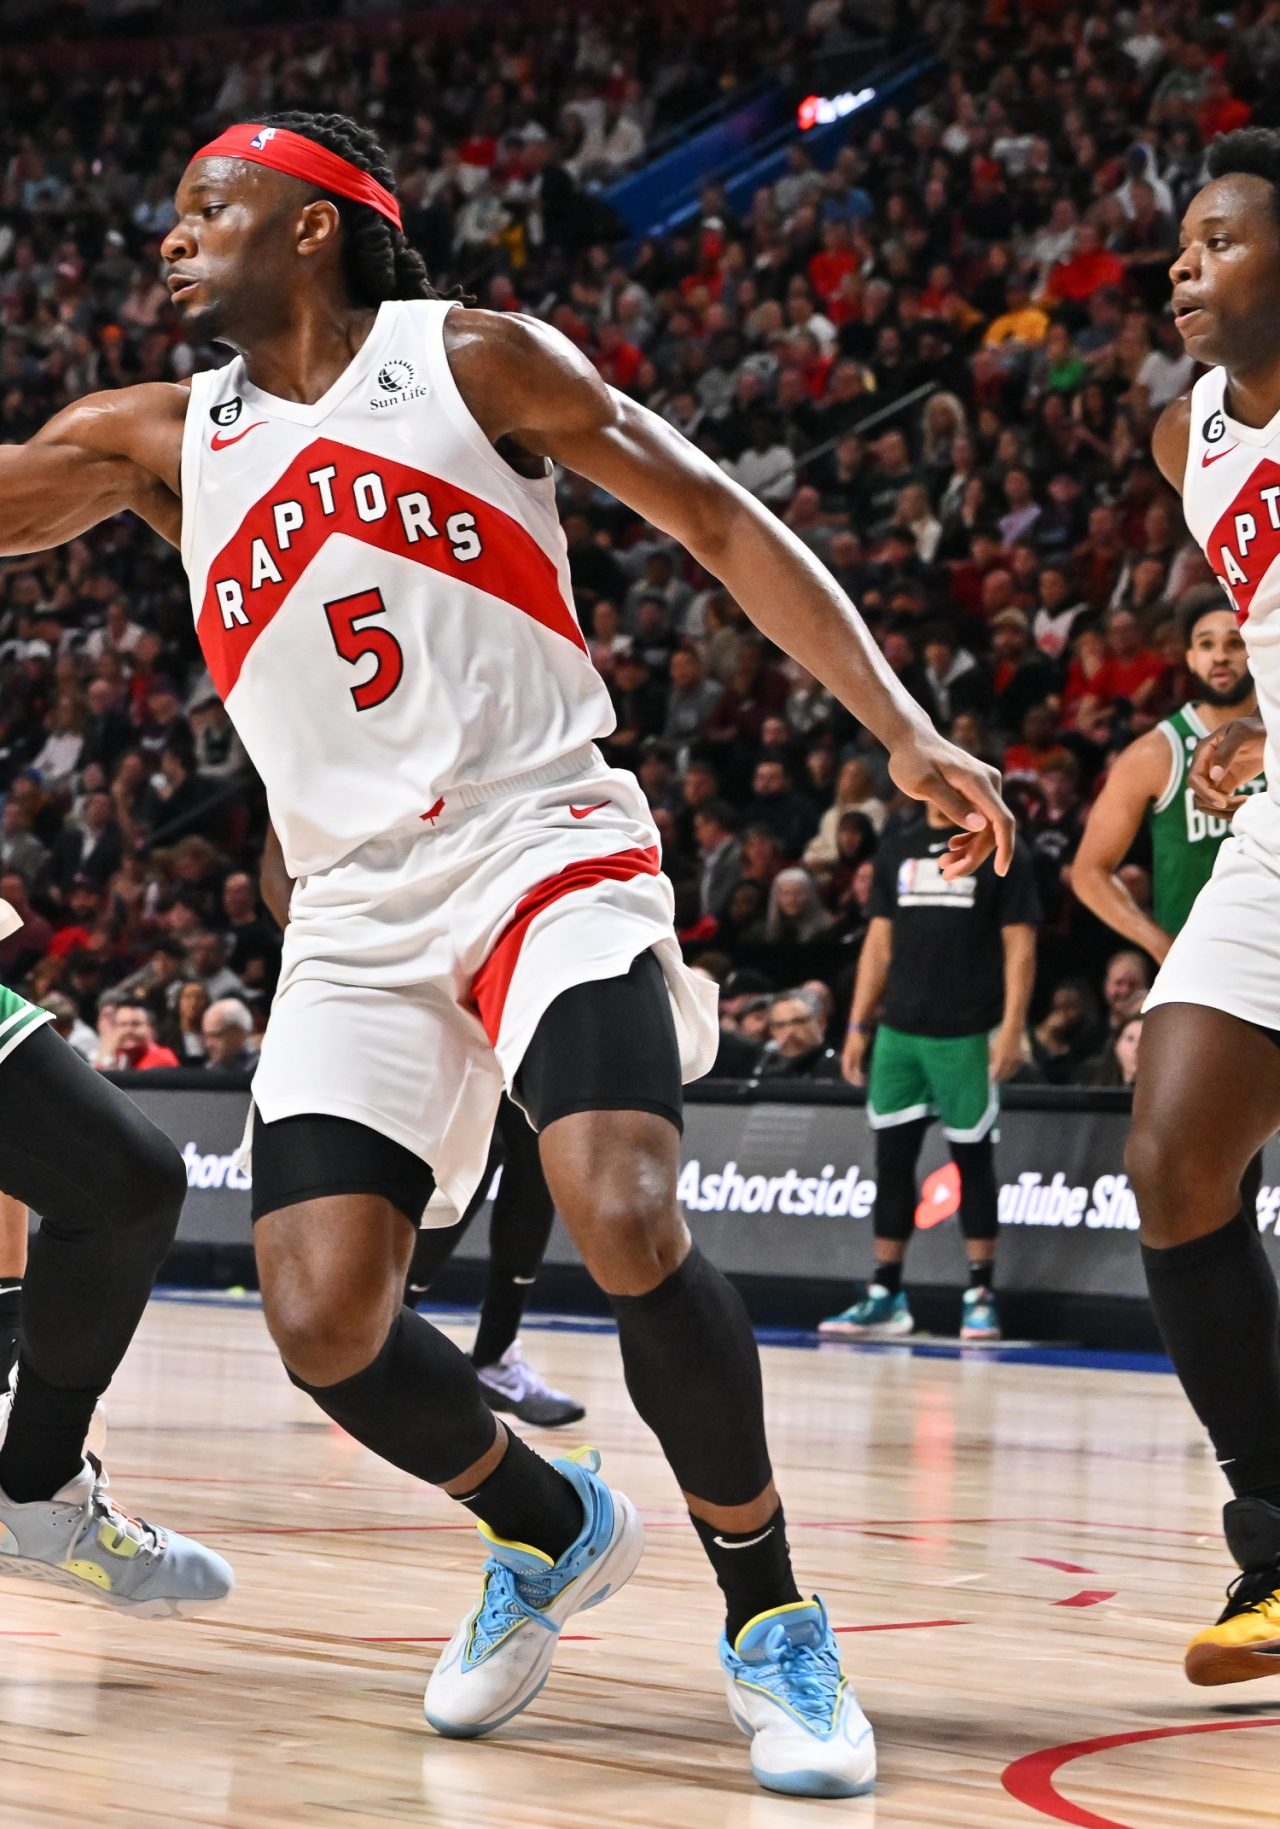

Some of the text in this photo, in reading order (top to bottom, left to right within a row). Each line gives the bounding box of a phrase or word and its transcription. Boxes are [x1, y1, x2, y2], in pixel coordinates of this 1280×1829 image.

[215, 400, 239, 425] 6
[370, 385, 427, 411] Sun Life
[1205, 412, 1224, 441] 6
[215, 464, 483, 631] RAPTORS
[323, 586, 404, 712] 5
[676, 1159, 878, 1219] Ashortside
